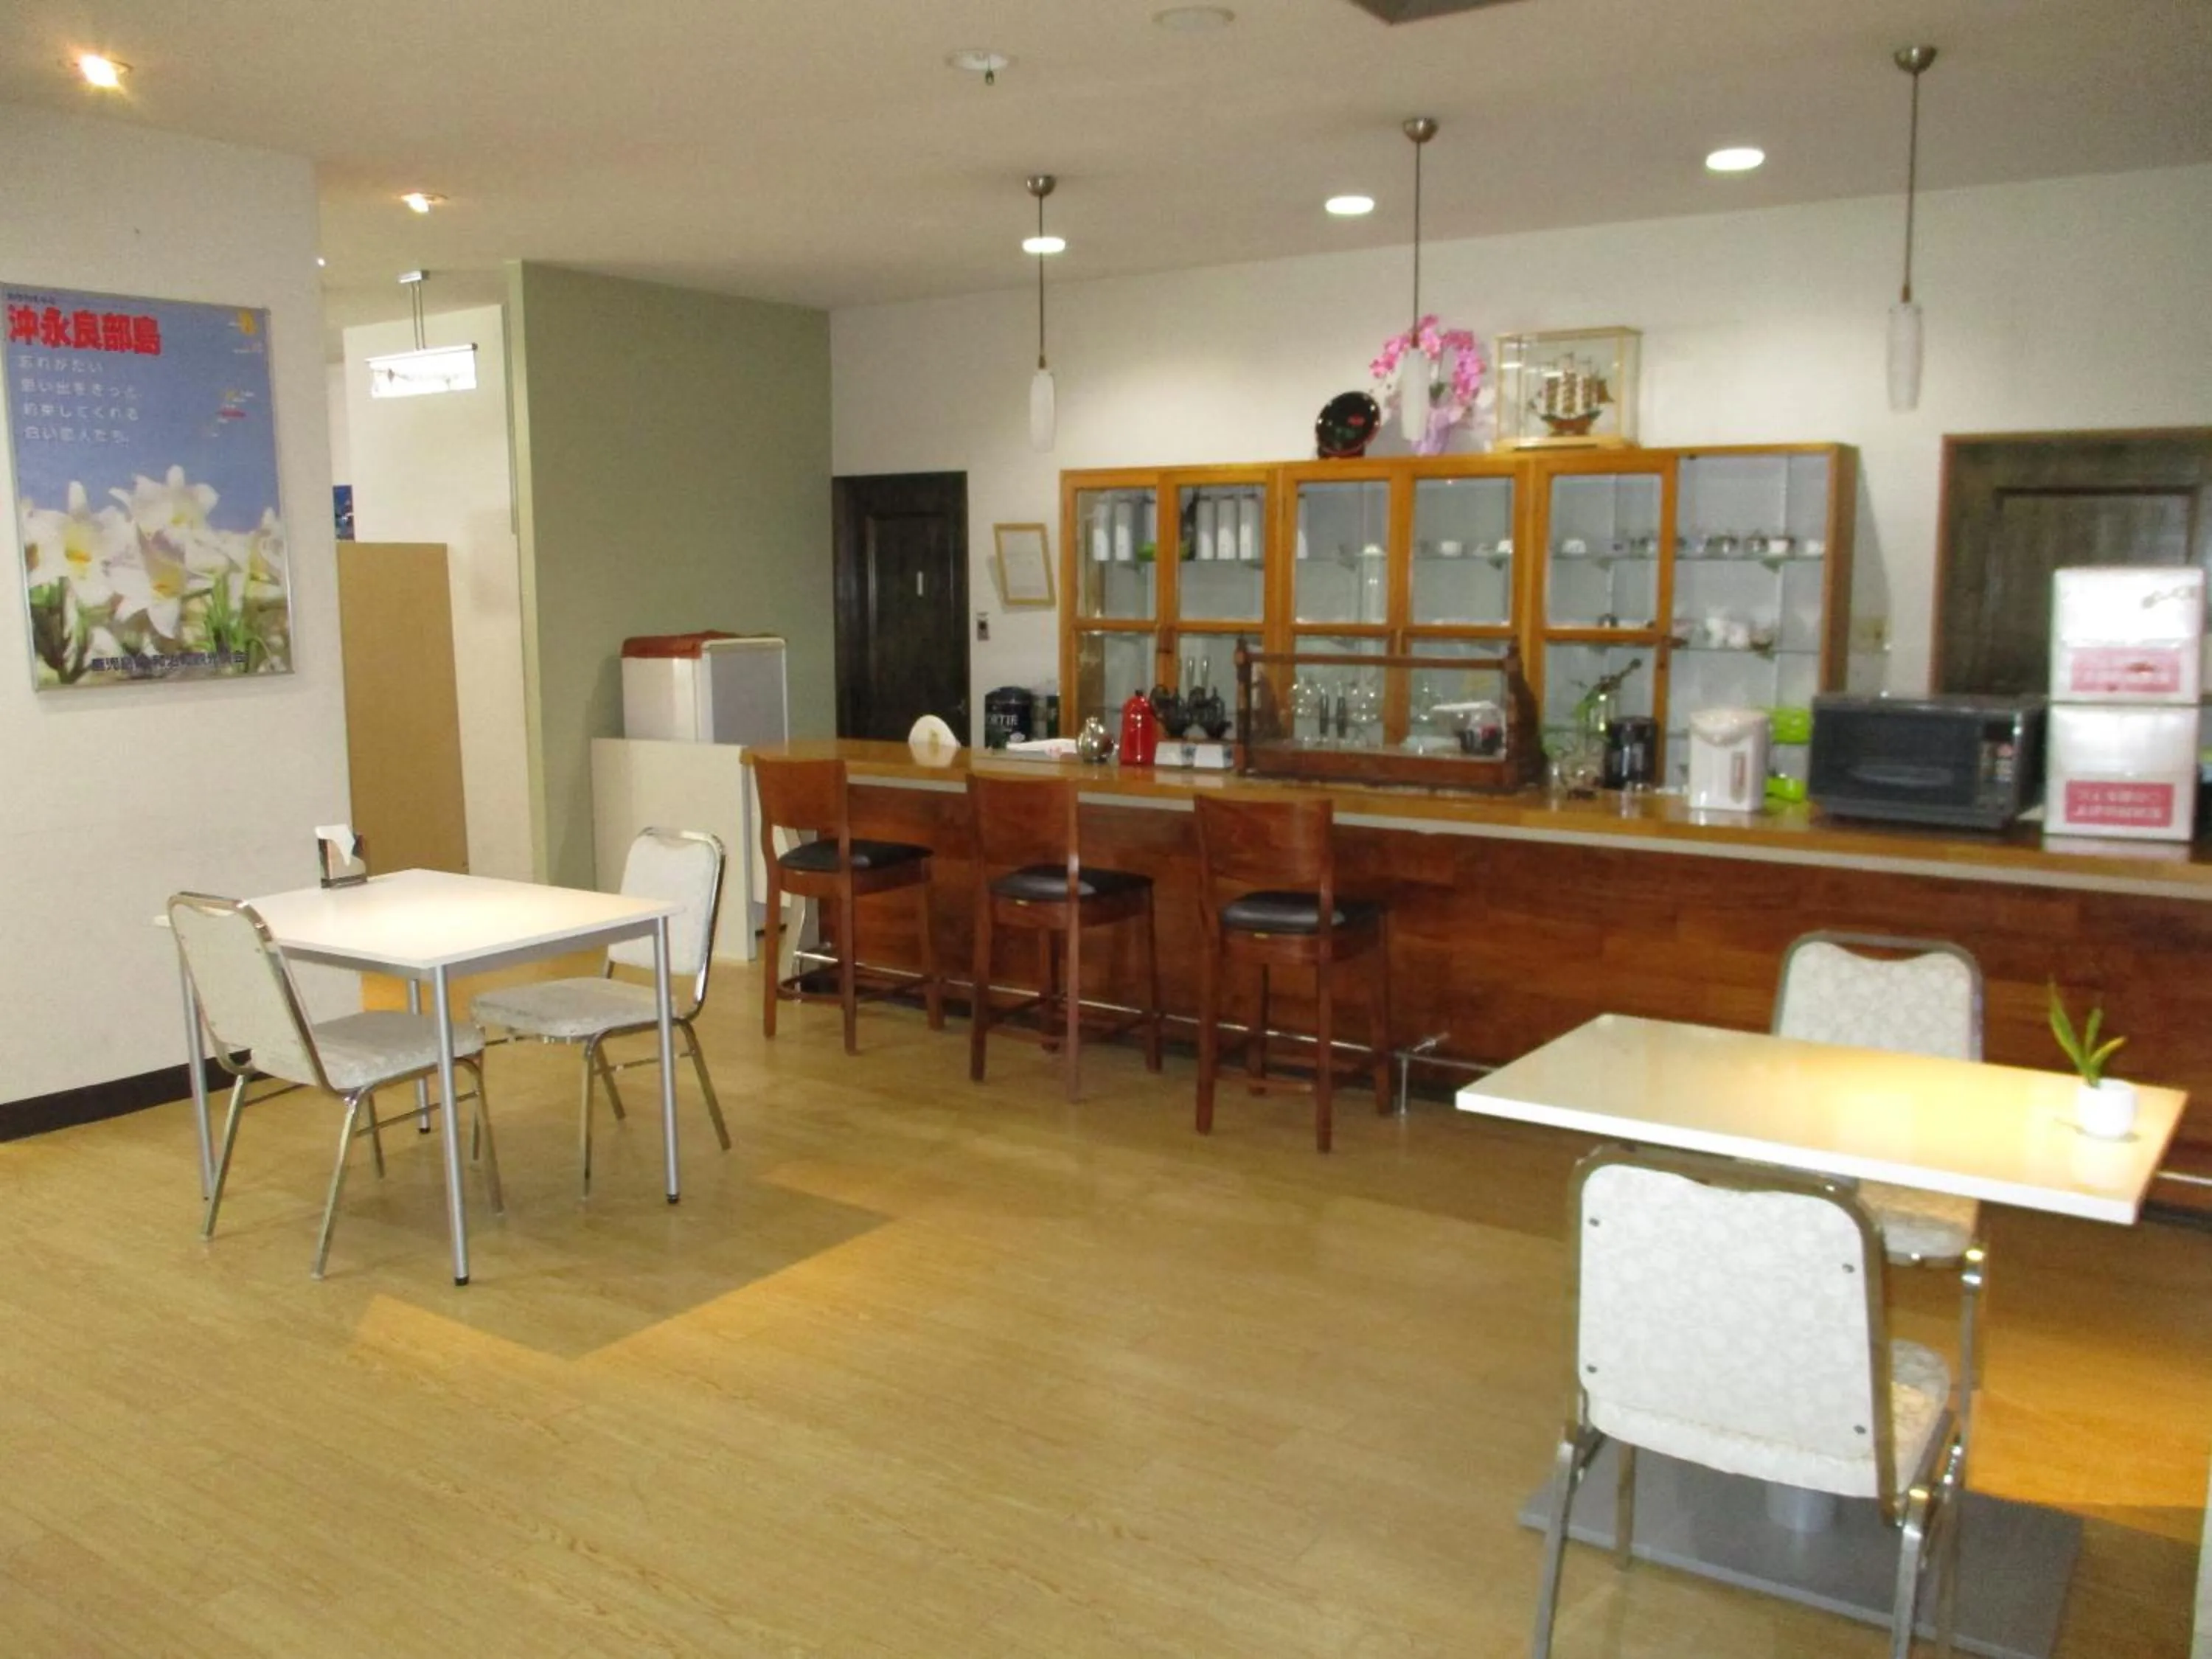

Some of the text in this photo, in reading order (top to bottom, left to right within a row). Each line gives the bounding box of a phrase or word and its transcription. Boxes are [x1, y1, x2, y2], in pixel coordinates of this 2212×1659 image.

[7, 304, 161, 355] 沖永良部島
